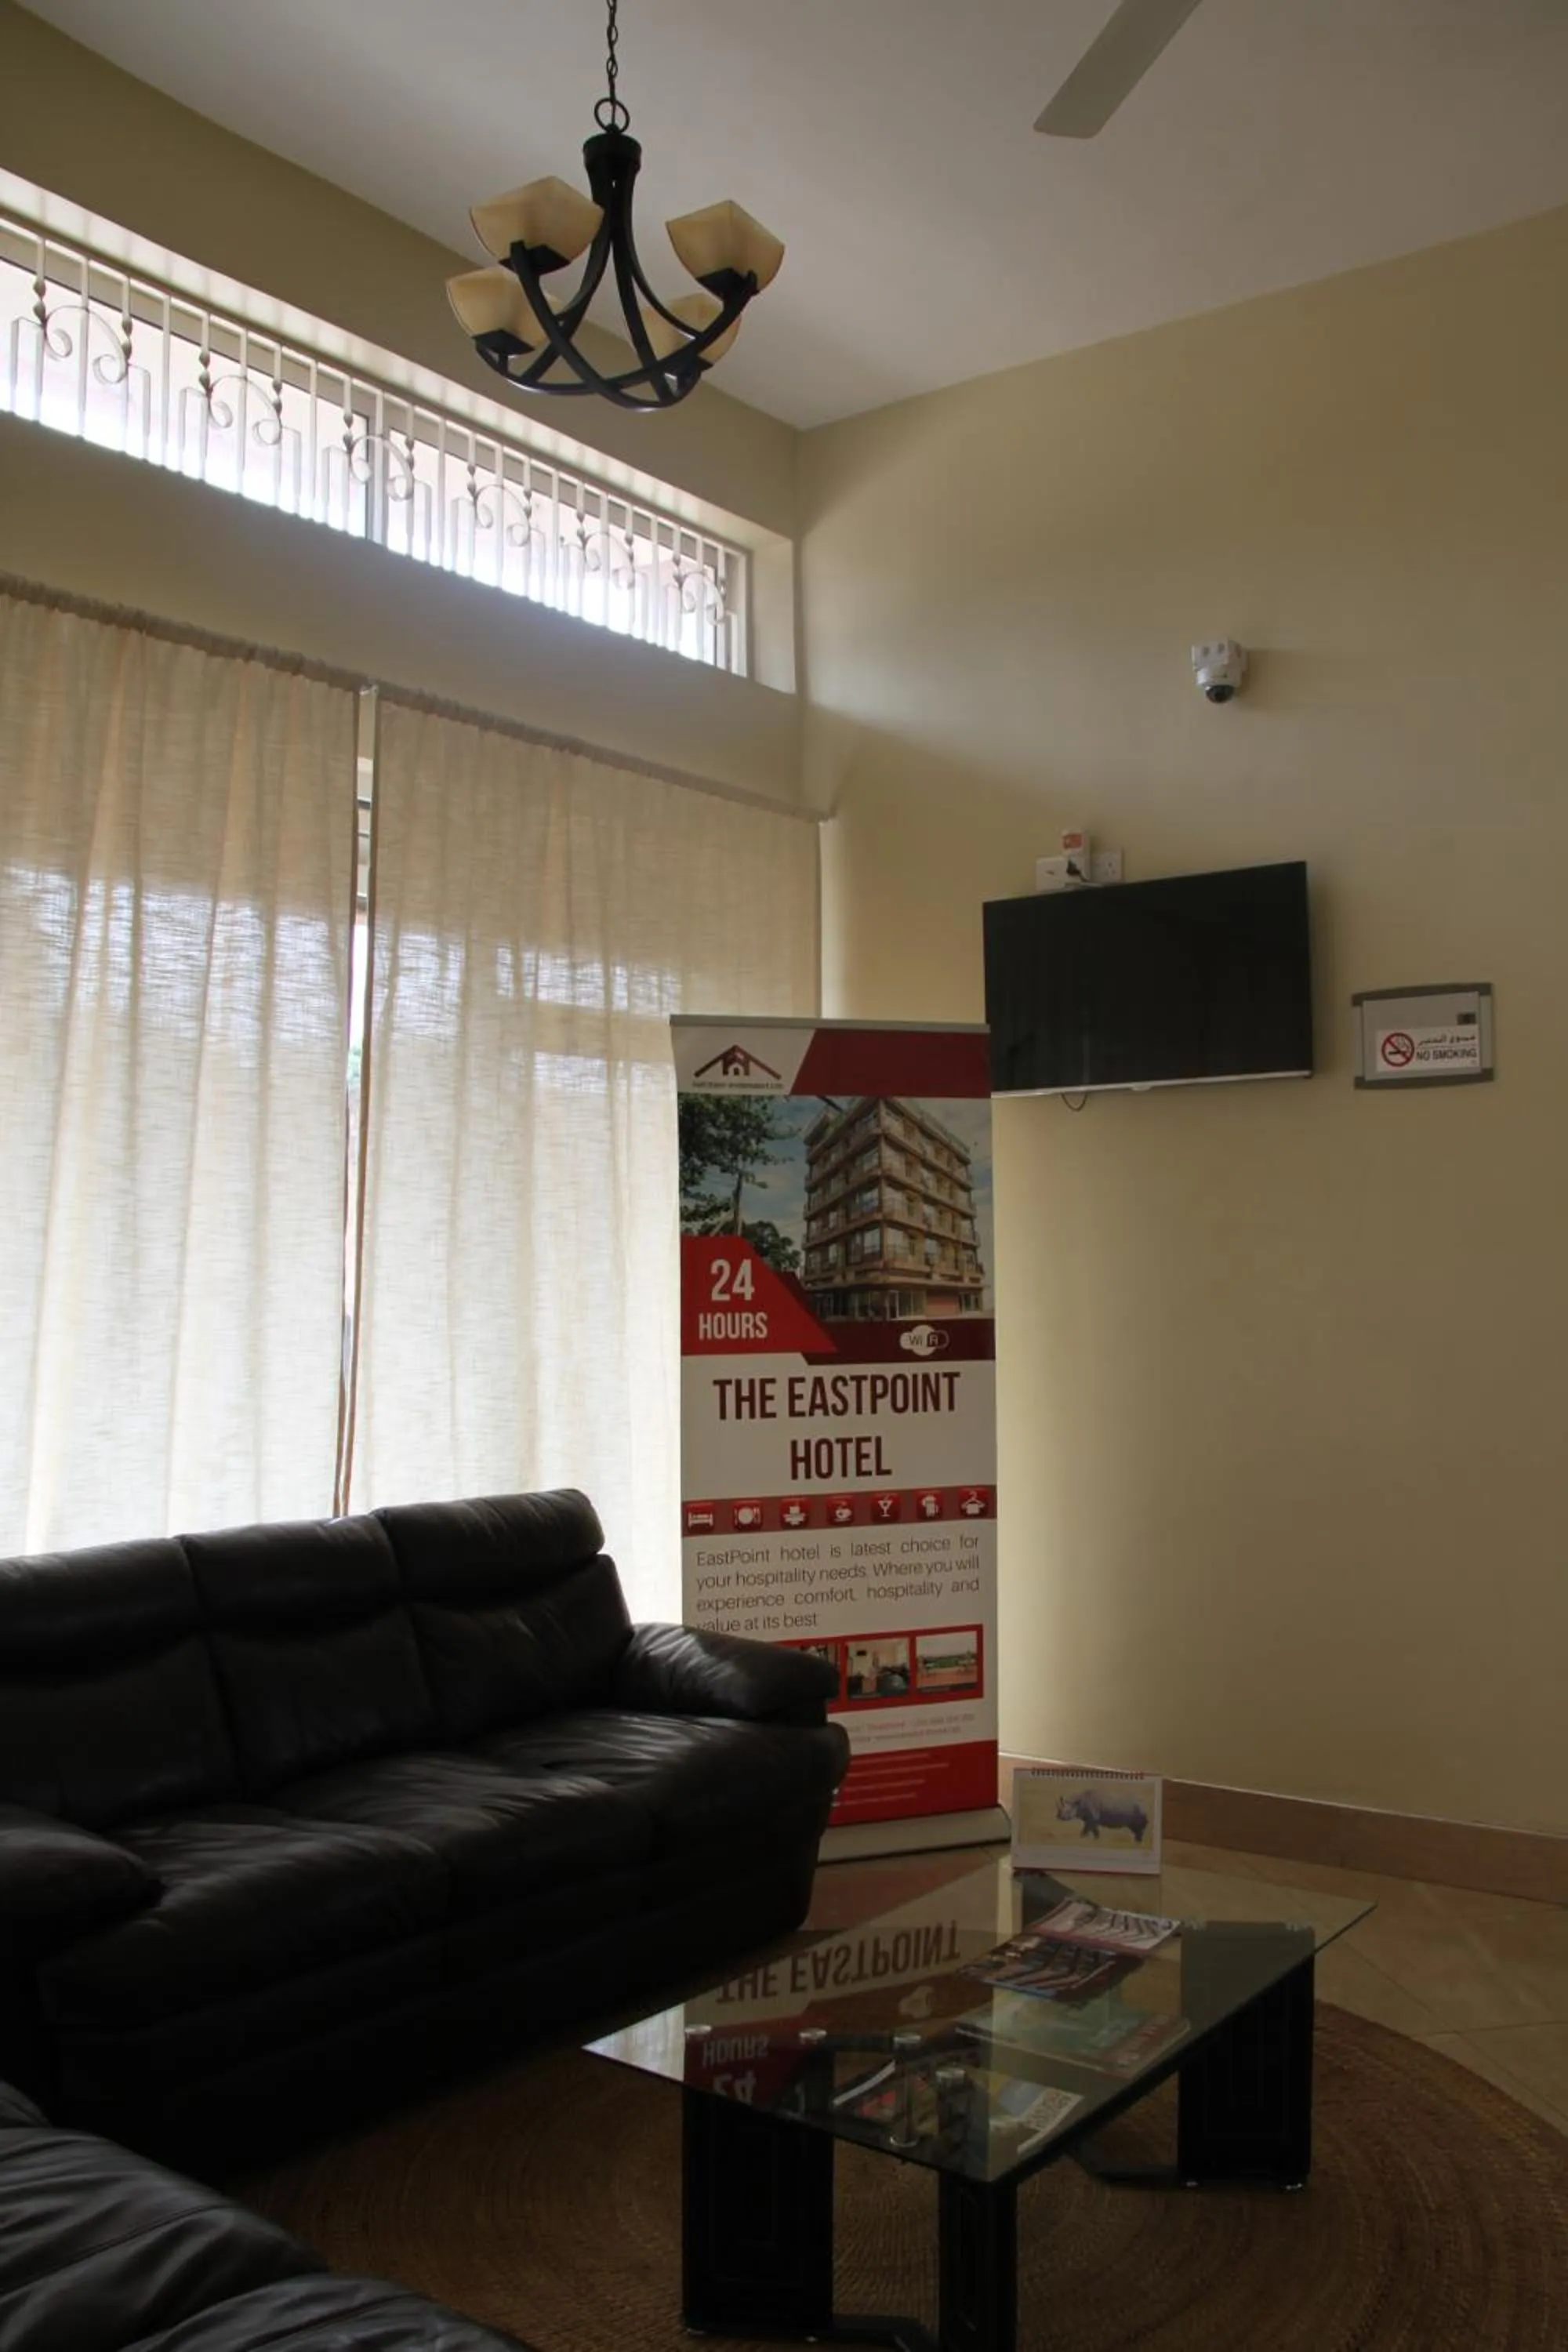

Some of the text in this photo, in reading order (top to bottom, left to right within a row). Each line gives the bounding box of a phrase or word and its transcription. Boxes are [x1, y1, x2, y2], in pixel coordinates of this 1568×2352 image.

[1416, 1048, 1477, 1062] NO SMOKING
[710, 1258, 755, 1301] 24
[698, 1312, 768, 1341] HOURS
[713, 1372, 961, 1421] THE EASTPOINT
[789, 1436, 893, 1480] HOTEL
[696, 1534, 979, 1566] EastPoint hotel is latest choice for
[696, 1574, 731, 1592] your
[735, 1567, 816, 1588] hospitality
[873, 1560, 924, 1577] Where
[924, 1560, 953, 1575] you
[955, 1555, 980, 1571] will
[696, 1594, 785, 1613] experience
[866, 1580, 943, 1601] hospitality
[951, 1578, 980, 1593] and
[743, 1617, 759, 1632] at
[763, 1615, 780, 1630] its
